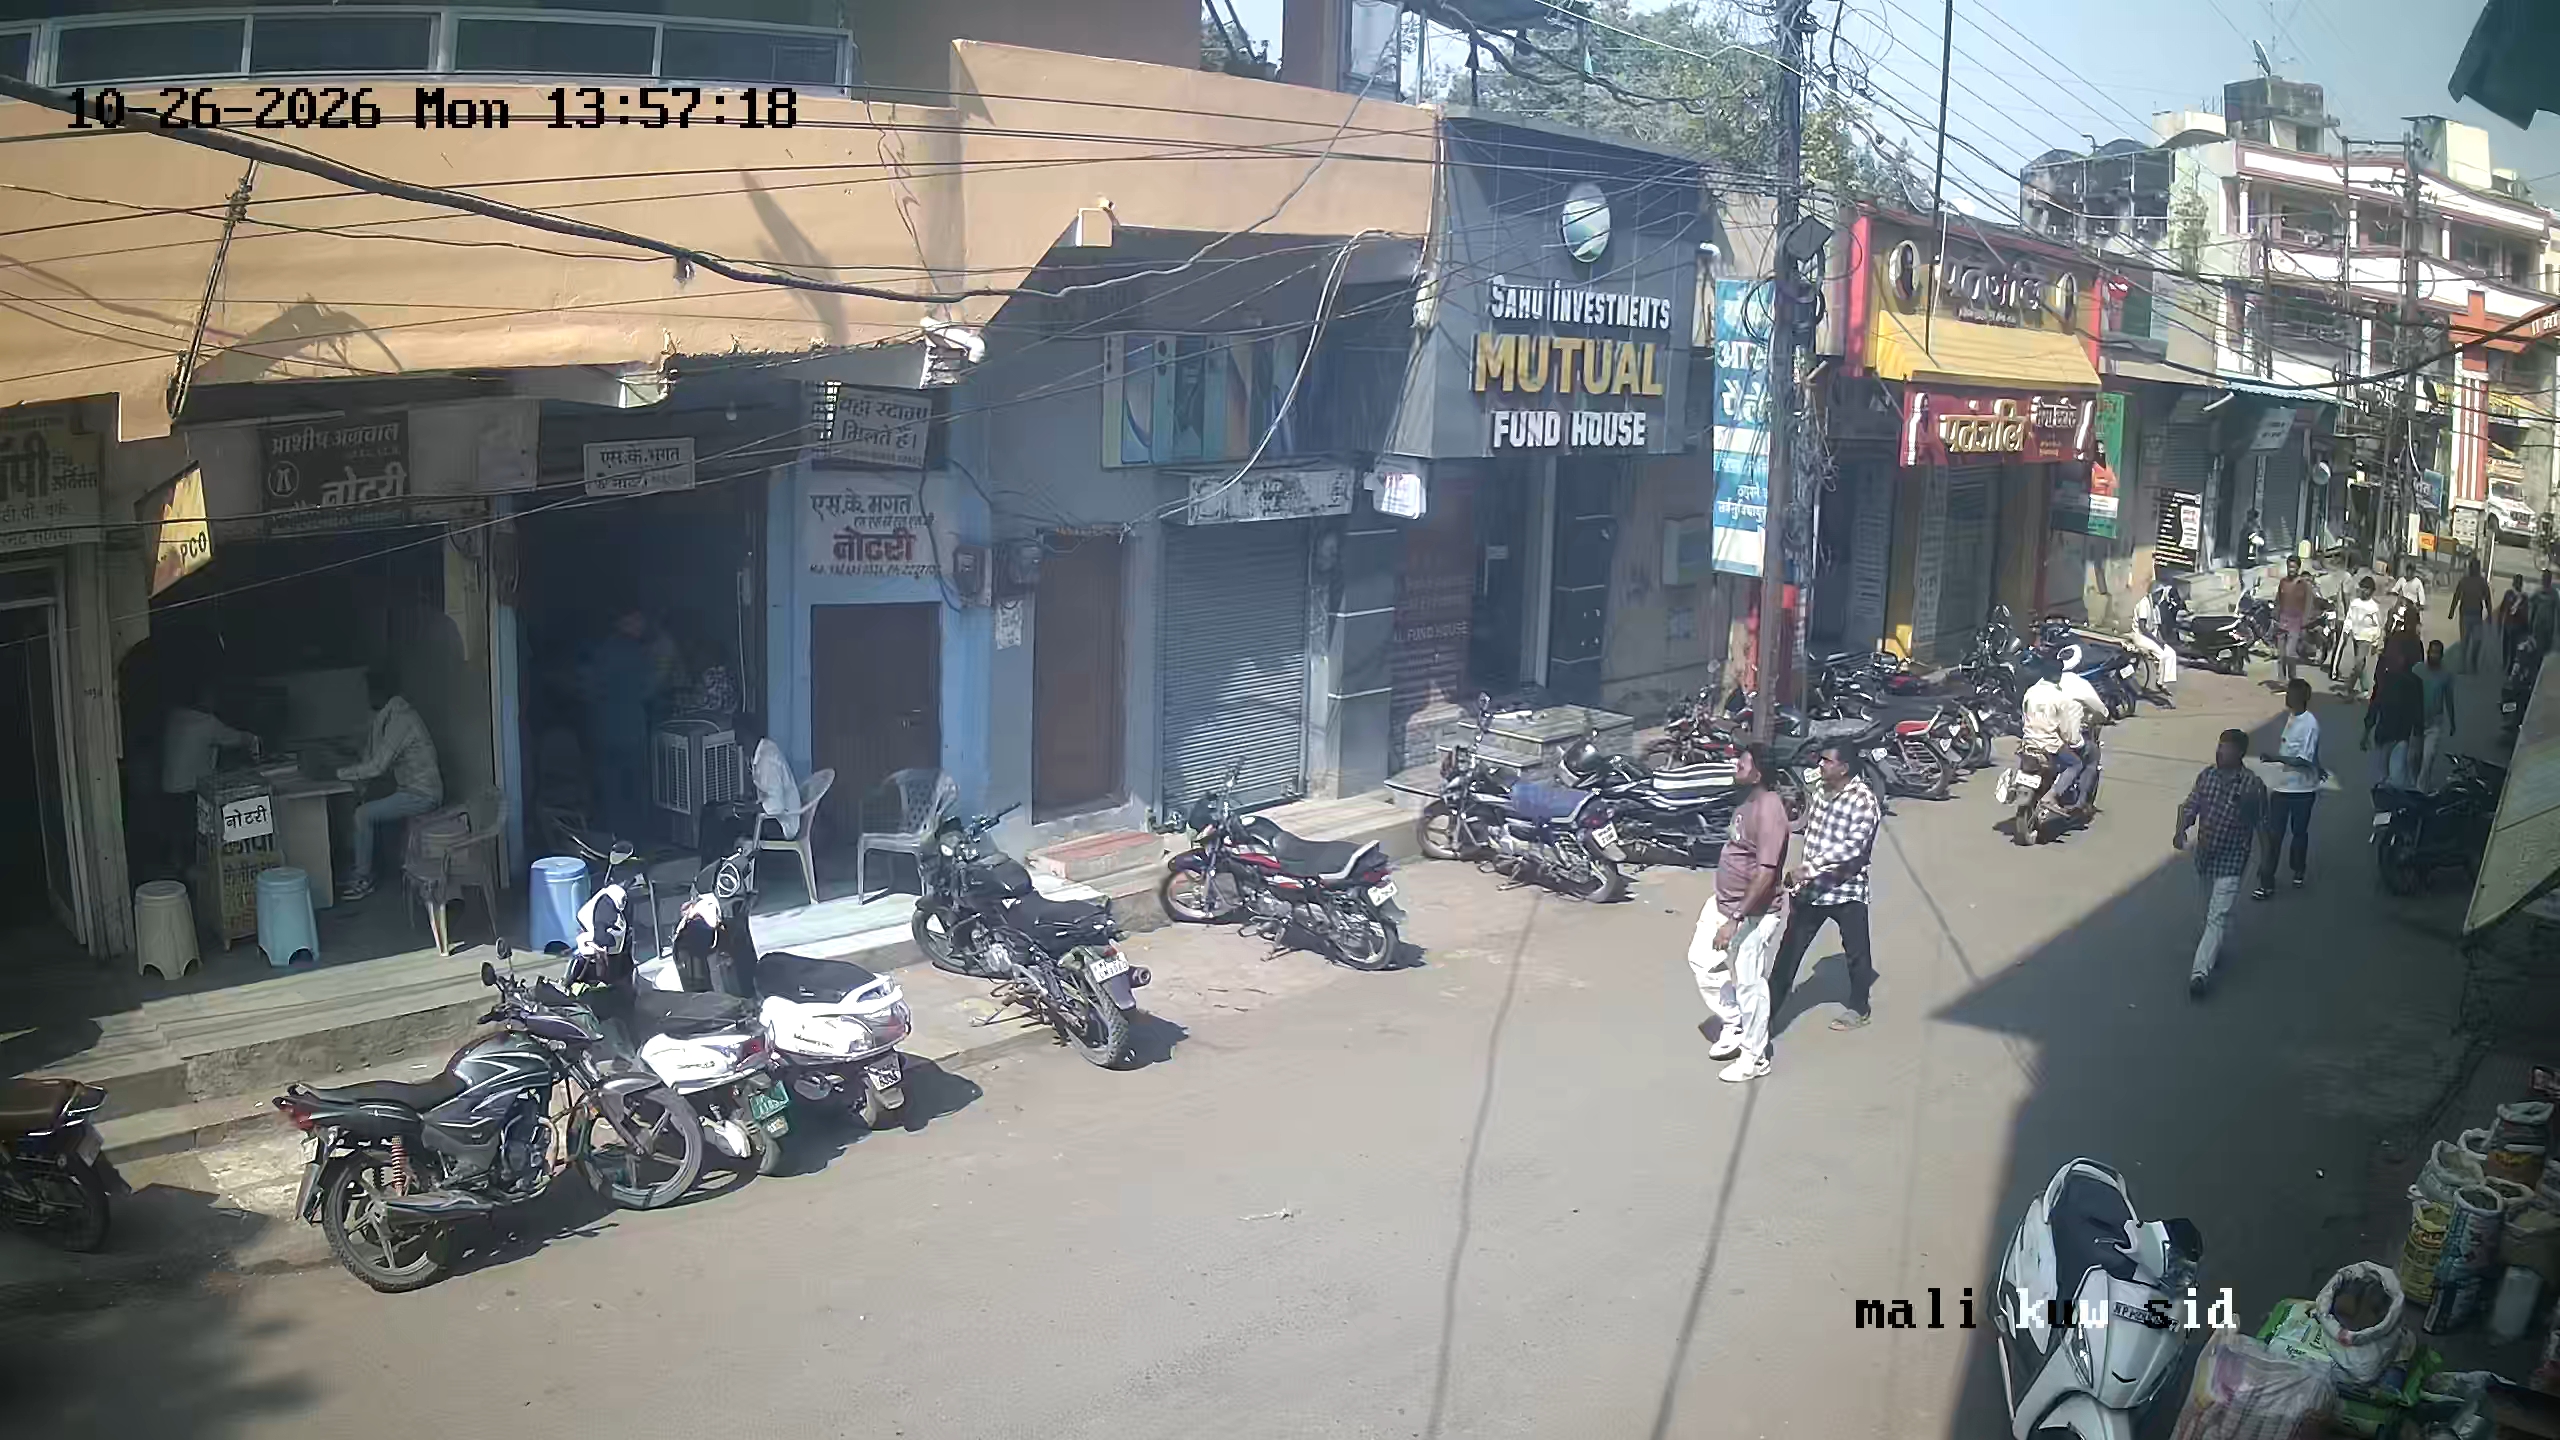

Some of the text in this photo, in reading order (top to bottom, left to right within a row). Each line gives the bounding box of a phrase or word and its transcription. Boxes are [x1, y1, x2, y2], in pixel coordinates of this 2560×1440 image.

[1491, 275, 1671, 330] SAHU INVESTMENTS
[1474, 331, 1664, 395] MUTUAL
[1493, 410, 1646, 447] FUND HOUSE
[320, 460, 407, 506] नोटरी
[180, 530, 207, 565] PCO
[832, 526, 917, 561] नोटरी
[224, 804, 268, 829] नोटरी
